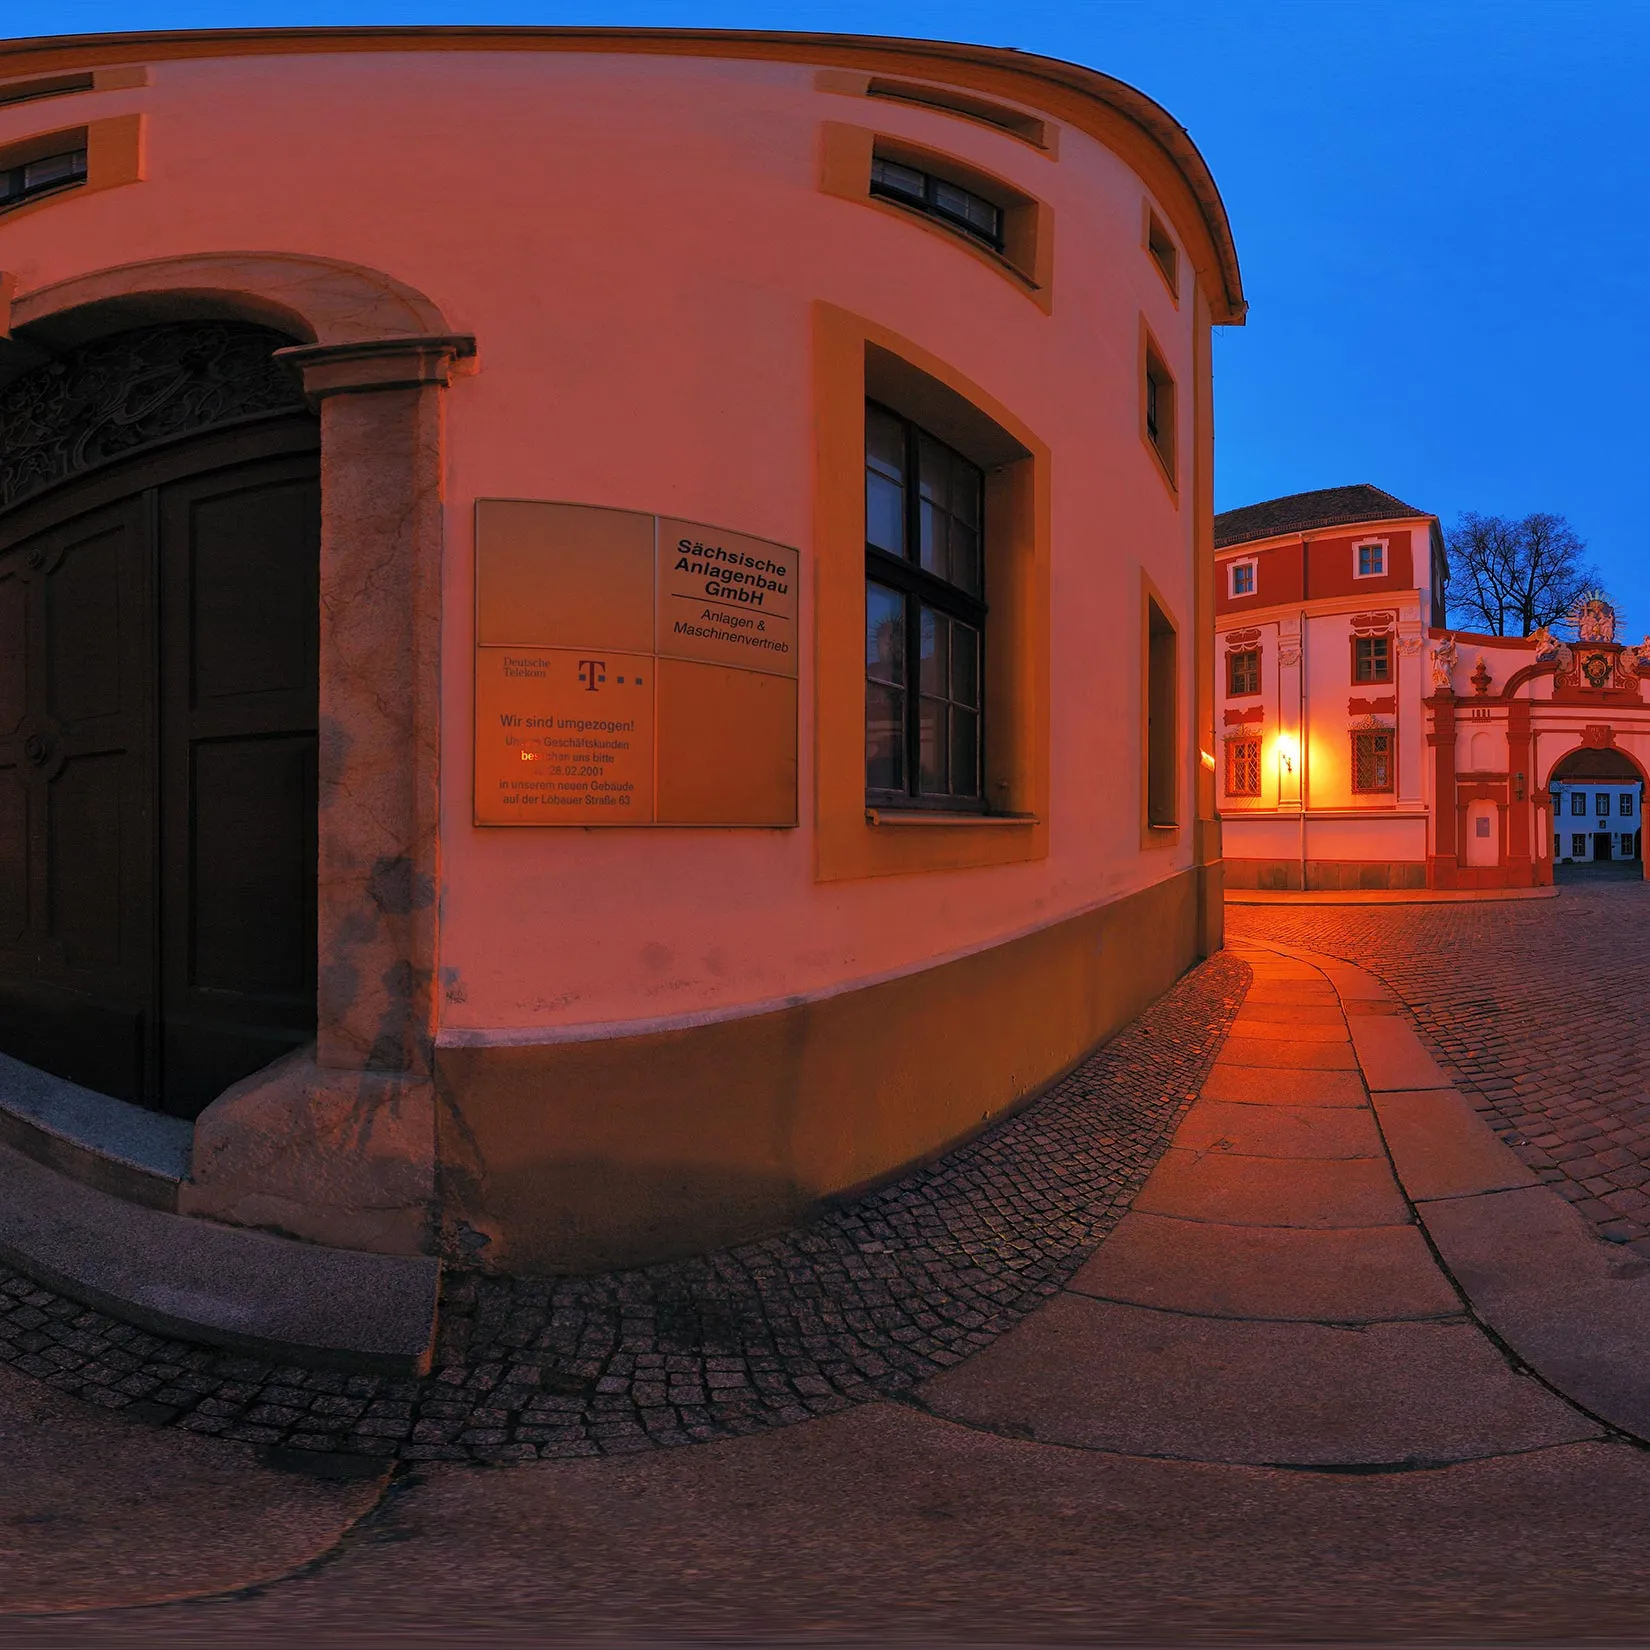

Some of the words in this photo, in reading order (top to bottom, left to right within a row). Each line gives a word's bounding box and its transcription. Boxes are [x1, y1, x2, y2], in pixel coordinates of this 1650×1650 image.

[676, 539, 787, 577] Sächsische
[674, 557, 788, 595] Anlagenbau
[705, 581, 764, 605] GmbH
[701, 608, 754, 629] Anlagen
[757, 619, 766, 632] &
[673, 621, 789, 653] Maschinenvertrieb
[503, 656, 551, 668] Deutsche
[502, 667, 547, 678] Telekom
[500, 714, 523, 728] Wir
[525, 715, 554, 728] sind
[557, 719, 635, 734] umgezogen!
[572, 753, 591, 763] uns
[592, 752, 615, 764] bitte
[511, 780, 555, 790] unserem
[558, 782, 589, 791] neuen
[503, 794, 519, 805] auf
[521, 794, 539, 805] der
[584, 795, 617, 806] Straße
[619, 796, 631, 806] 63
